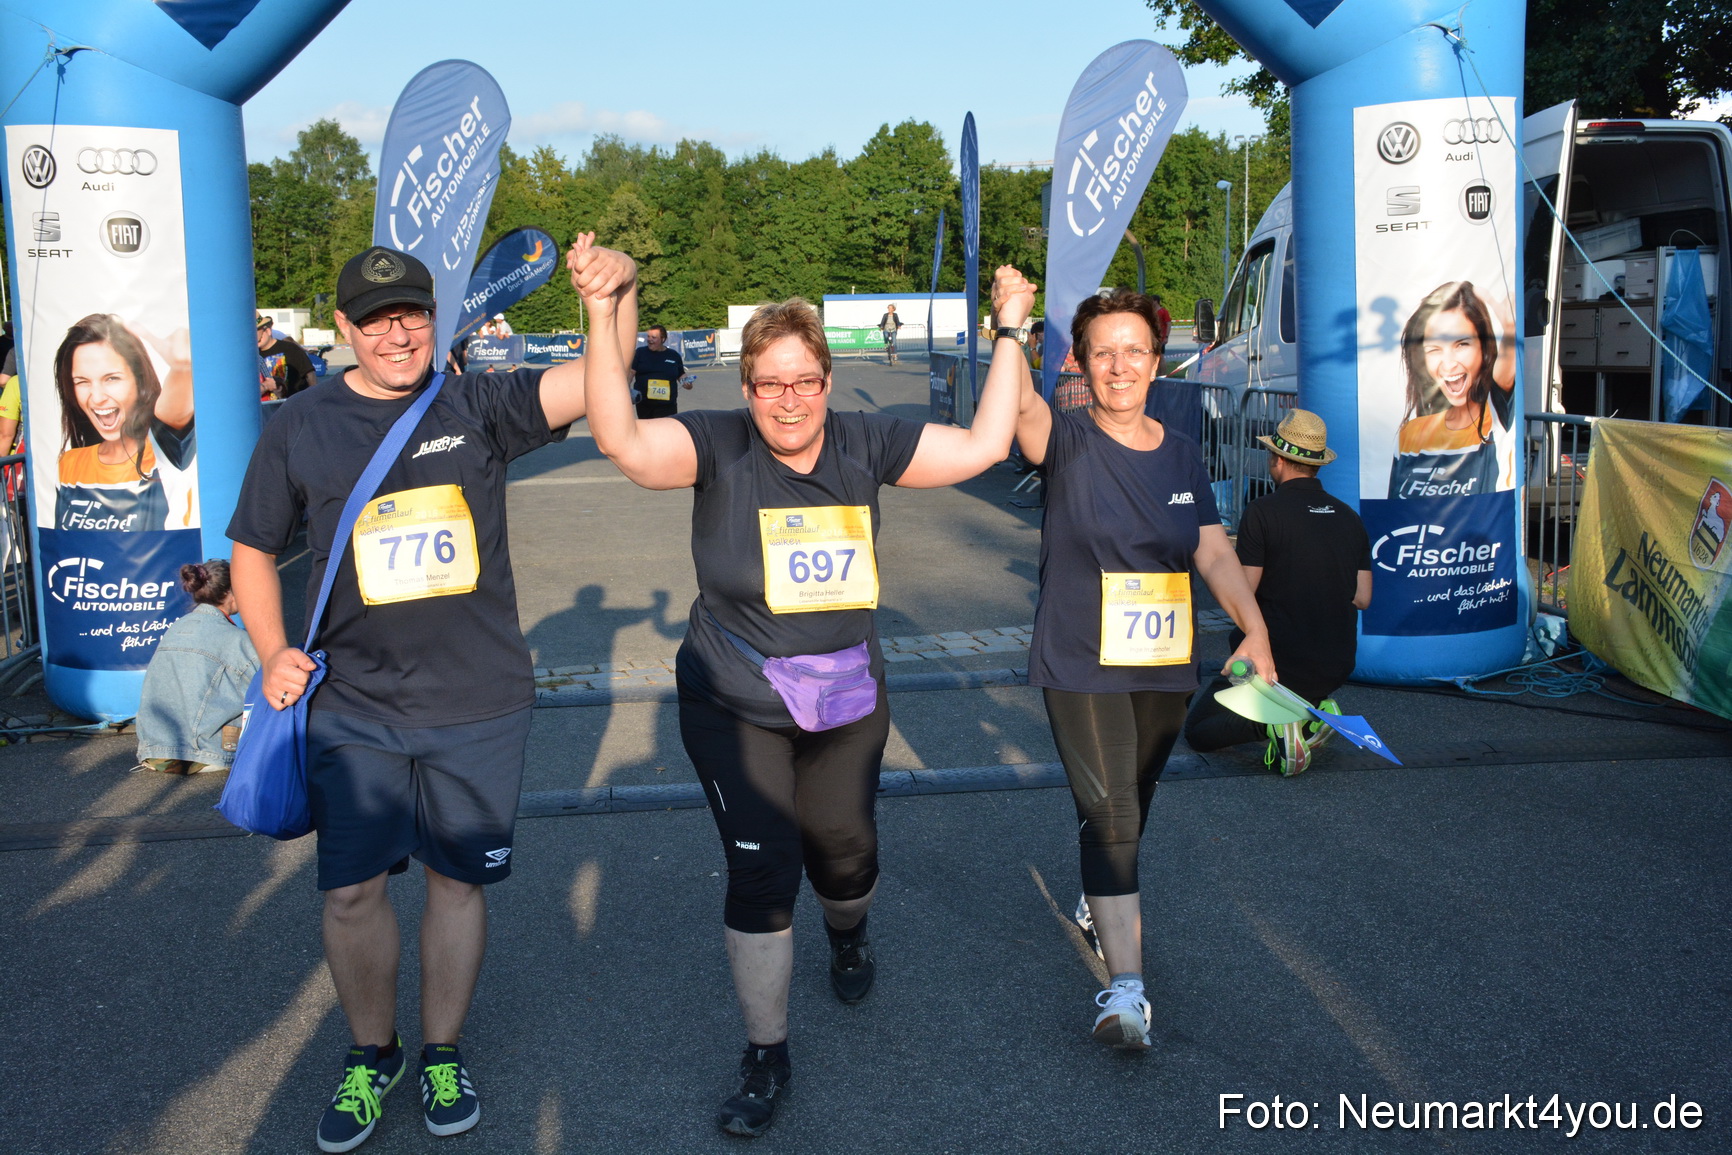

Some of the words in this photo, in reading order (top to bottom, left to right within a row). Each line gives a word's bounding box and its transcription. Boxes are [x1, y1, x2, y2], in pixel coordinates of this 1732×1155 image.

[1084, 71, 1159, 213] Fischer
[406, 95, 483, 228] Fischer
[1112, 97, 1167, 210] AUTOMOBILE
[1444, 151, 1474, 162] Audi
[81, 181, 115, 192] Audi
[431, 123, 491, 228] AUTOMOBILE
[1468, 191, 1490, 213] FIAT
[111, 224, 139, 246] FIAT
[1375, 220, 1432, 234] SEAT
[27, 249, 73, 258] SEAT
[463, 263, 532, 314] Frischmann
[473, 347, 509, 356] Fischer
[652, 387, 666, 395] 746
[1407, 477, 1477, 497] Fischer
[68, 512, 138, 532] Fischer
[379, 529, 456, 571] 776
[1396, 541, 1501, 566] Fischer
[1693, 541, 1708, 565] 1628
[788, 548, 856, 584] 697
[1407, 562, 1495, 578] AUTOMOBILE
[63, 576, 175, 600] Fischer
[1453, 585, 1475, 597] das
[72, 601, 166, 612] AUTOMOBILE
[116, 621, 140, 634] das
[141, 617, 180, 633] Läch
[1123, 609, 1176, 640] 701
